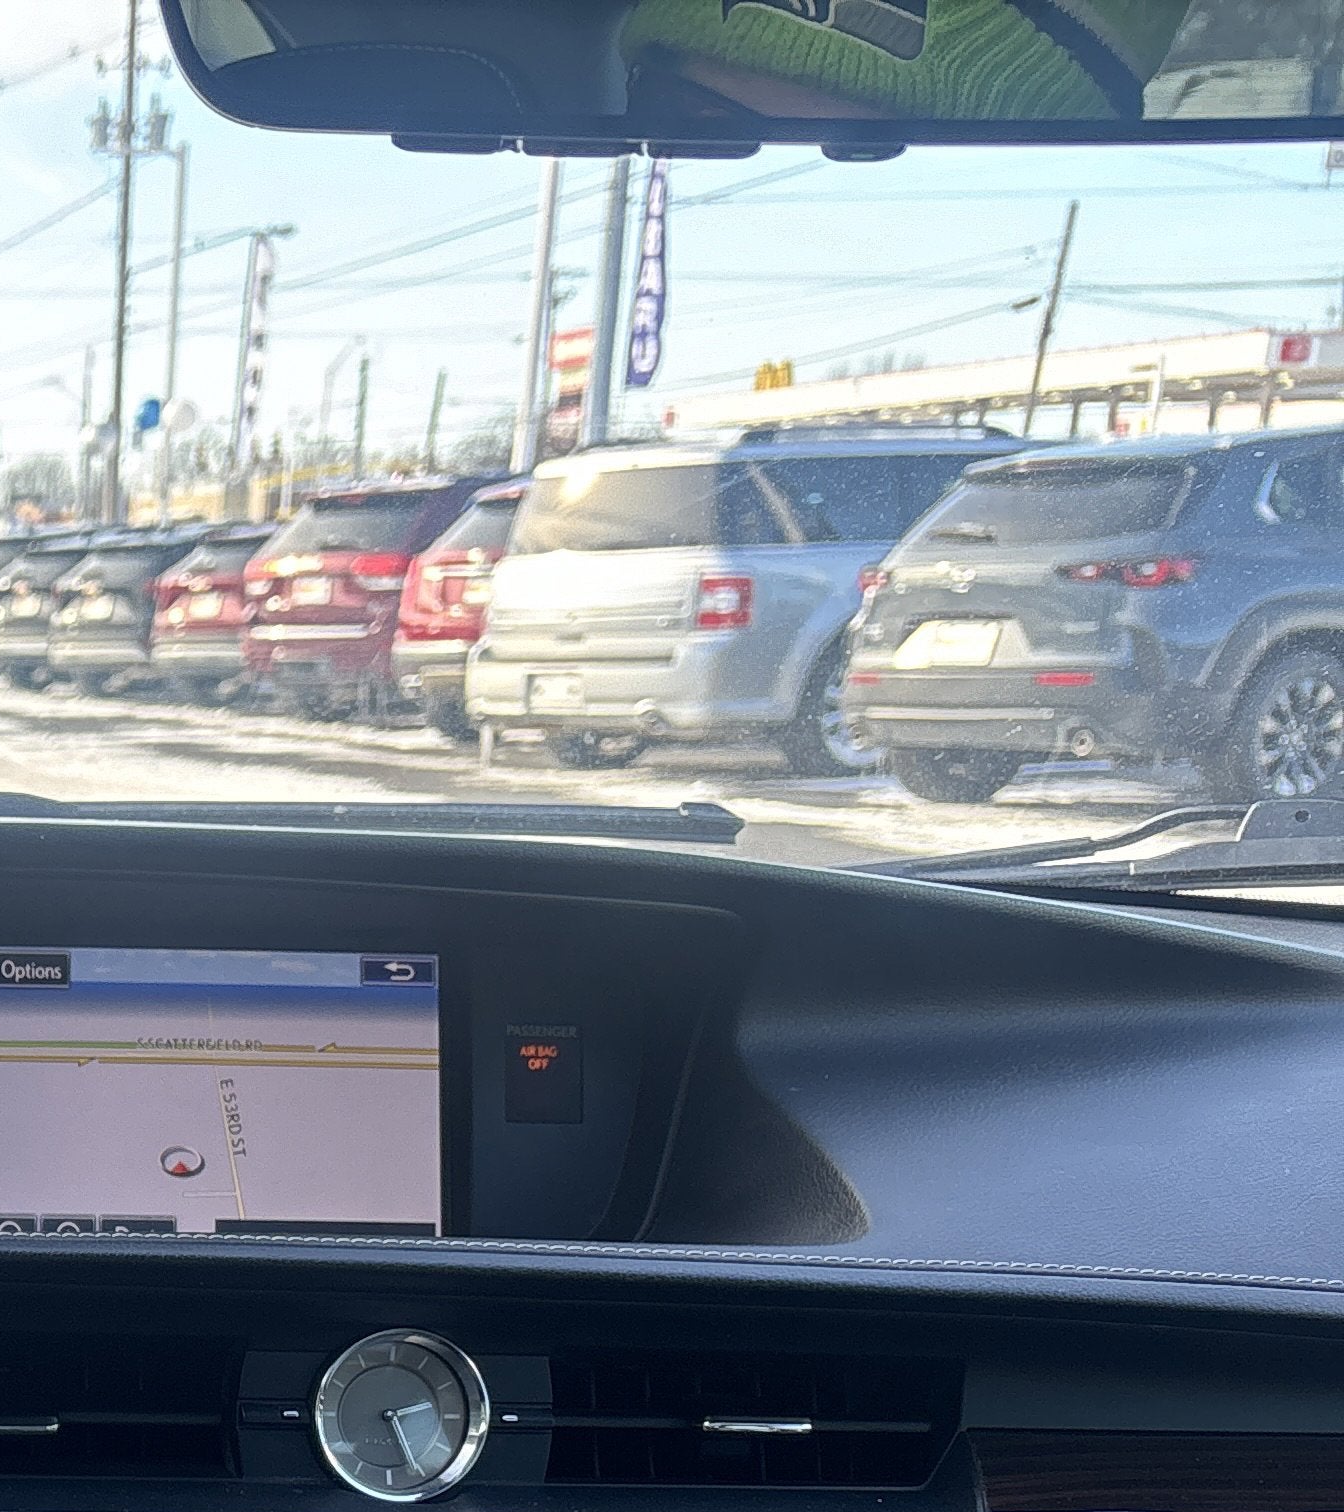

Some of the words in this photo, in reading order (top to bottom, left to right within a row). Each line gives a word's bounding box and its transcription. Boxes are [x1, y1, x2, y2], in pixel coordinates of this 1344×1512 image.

[0, 959, 62, 982] Options
[219, 1078, 233, 1091] E
[222, 1092, 242, 1136] 53RD
[231, 1137, 247, 1157] ST
